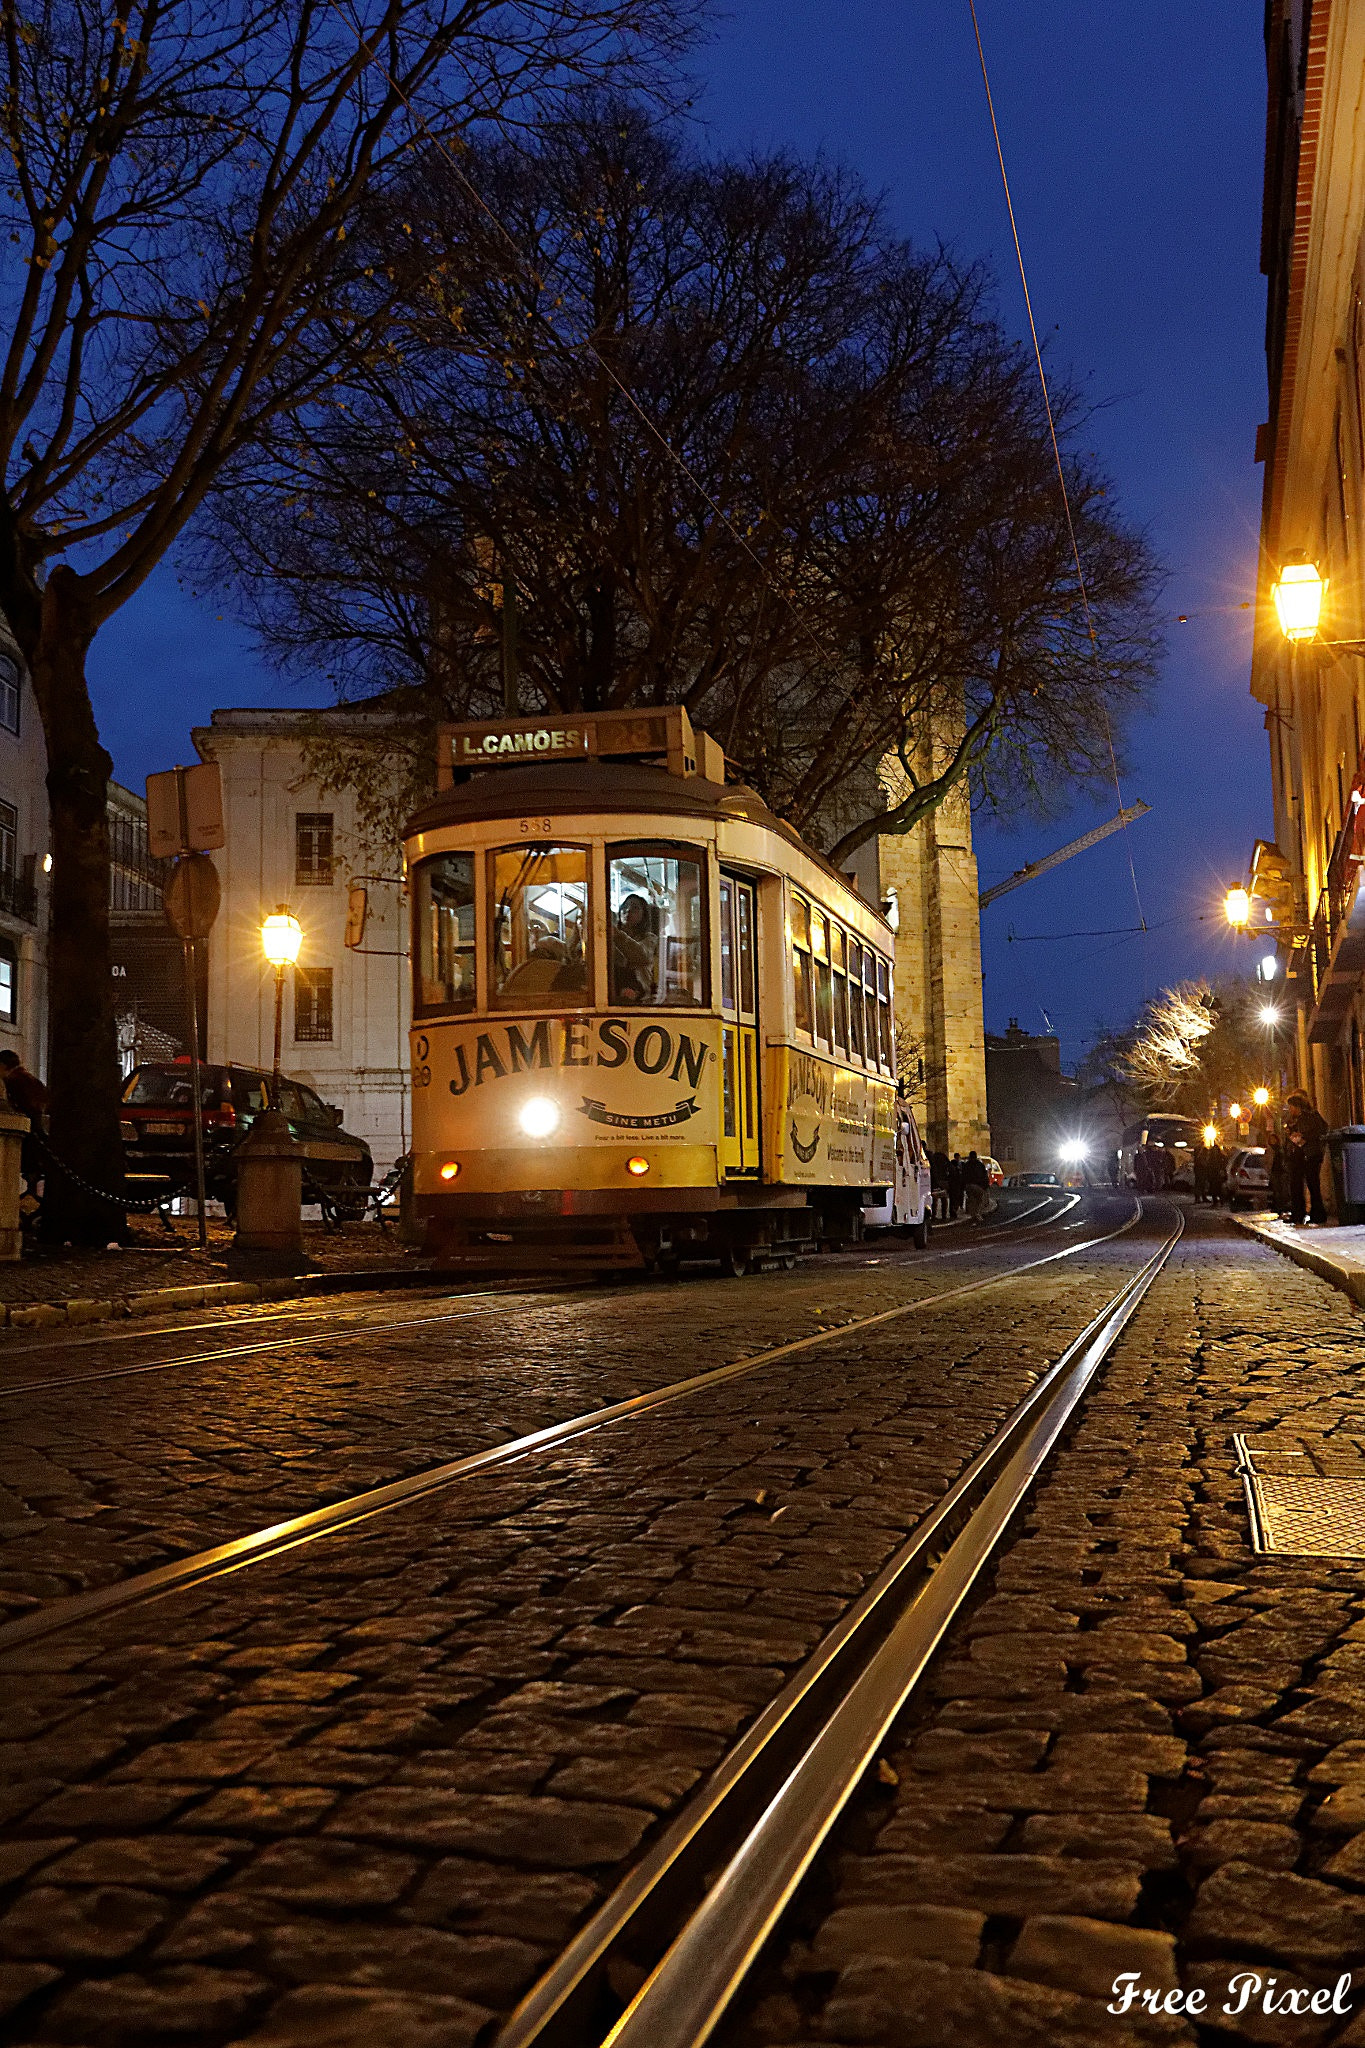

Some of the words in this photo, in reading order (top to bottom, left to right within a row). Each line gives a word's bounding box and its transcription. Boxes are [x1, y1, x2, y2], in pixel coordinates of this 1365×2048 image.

[449, 1018, 709, 1097] JAMESON
[606, 1115, 638, 1127] SINE
[643, 1114, 677, 1126] METU
